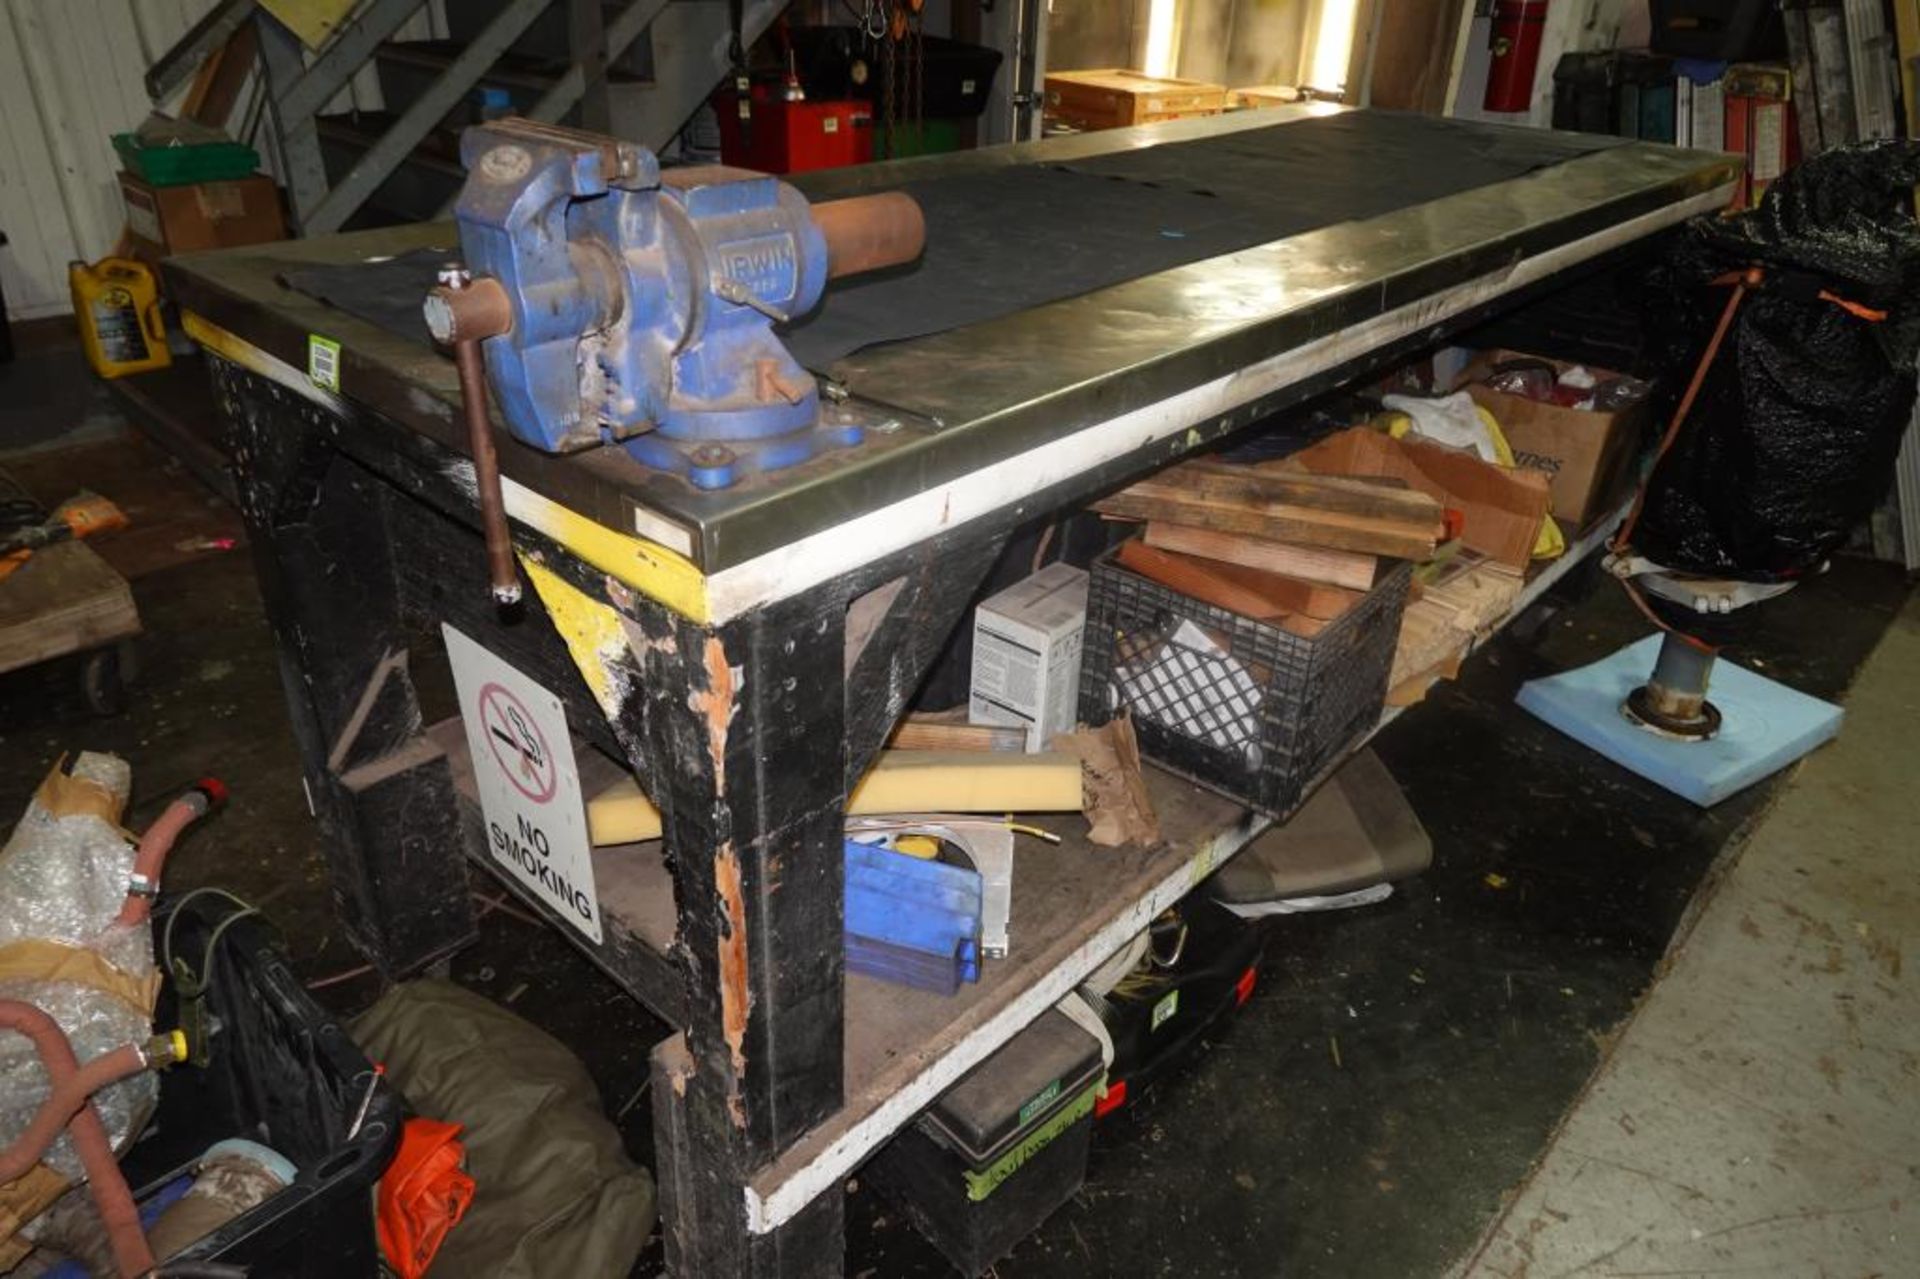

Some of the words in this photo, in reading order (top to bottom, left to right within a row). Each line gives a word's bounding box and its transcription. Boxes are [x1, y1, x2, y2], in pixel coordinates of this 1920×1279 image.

[720, 243, 793, 280] IRWIN
[517, 813, 550, 858] NO
[491, 822, 593, 922] SMOKING
